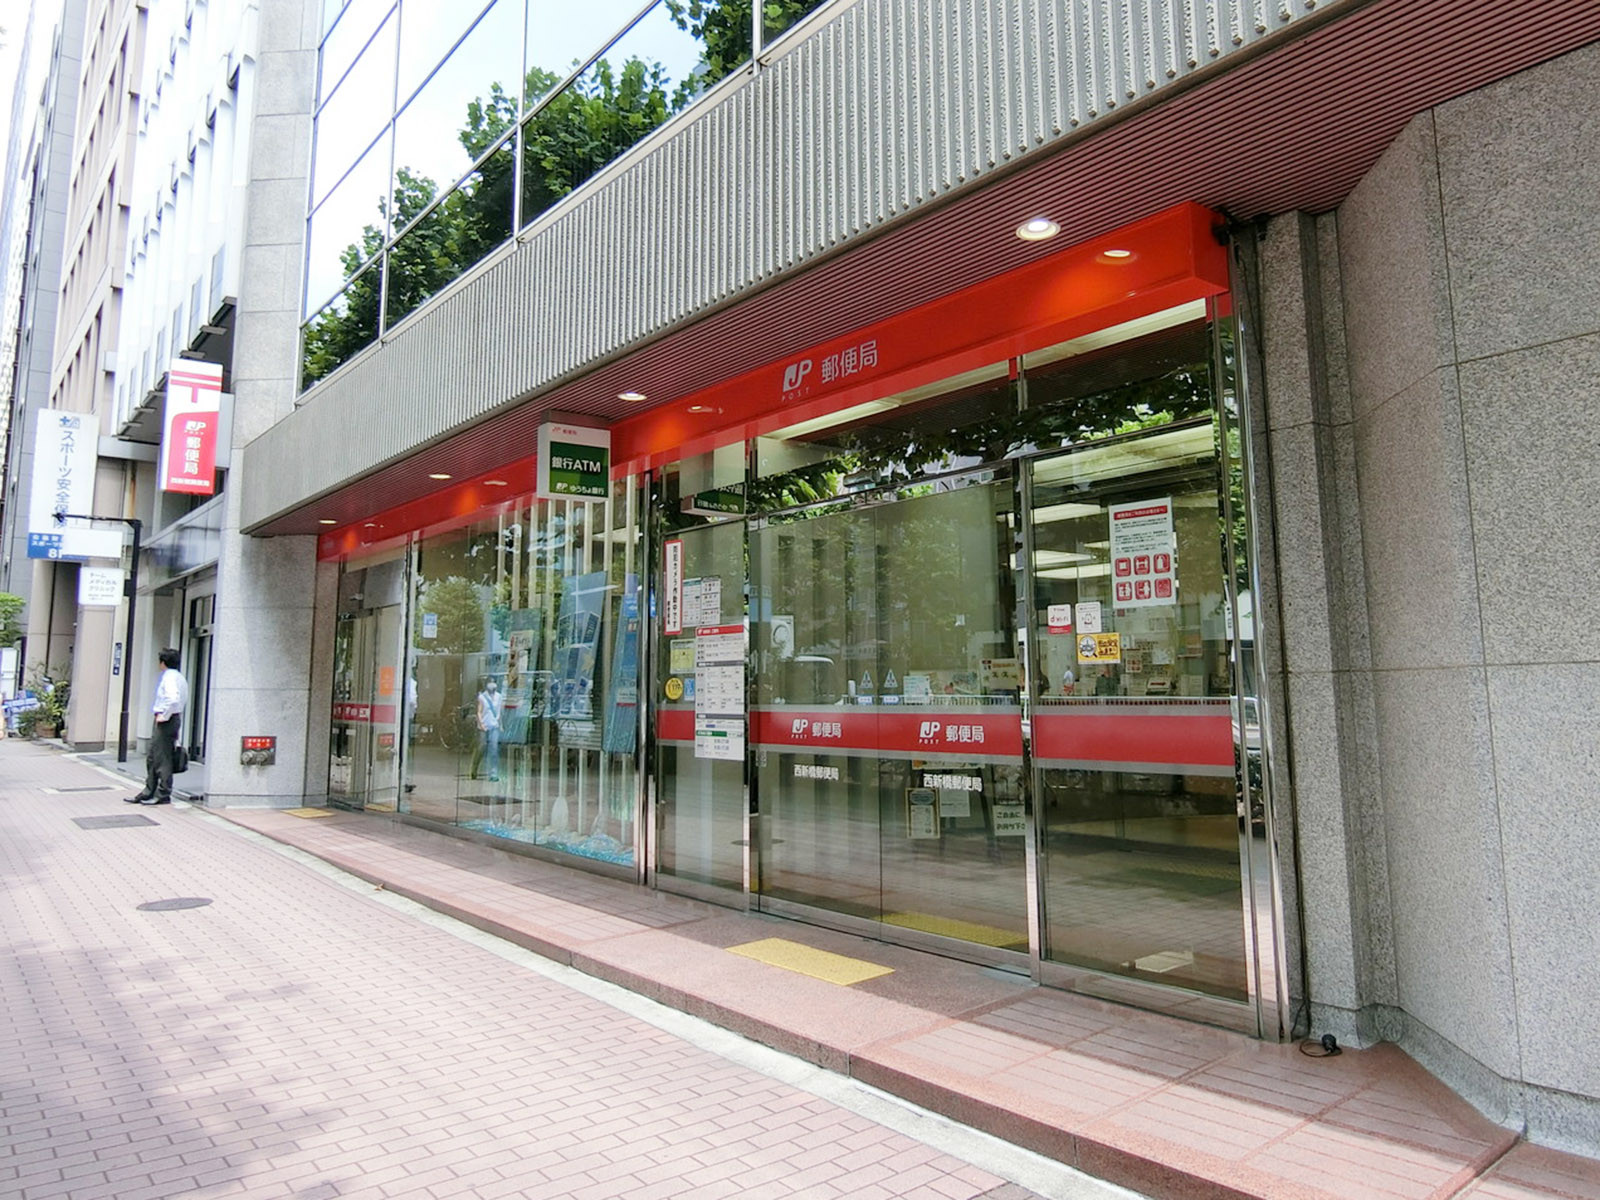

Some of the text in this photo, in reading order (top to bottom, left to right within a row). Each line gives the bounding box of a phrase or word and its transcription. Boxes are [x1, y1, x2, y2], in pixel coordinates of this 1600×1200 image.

[821, 340, 878, 384] 郵便局
[184, 436, 201, 475] 郵便局
[551, 456, 601, 473] 銀行ATM
[569, 485, 605, 495] ゆうちょ銀行
[812, 722, 842, 738] 郵便局
[945, 725, 984, 743] 郵便局
[793, 764, 839, 780] 西新橋郵便局
[923, 773, 982, 792] 西新橋郵便局
